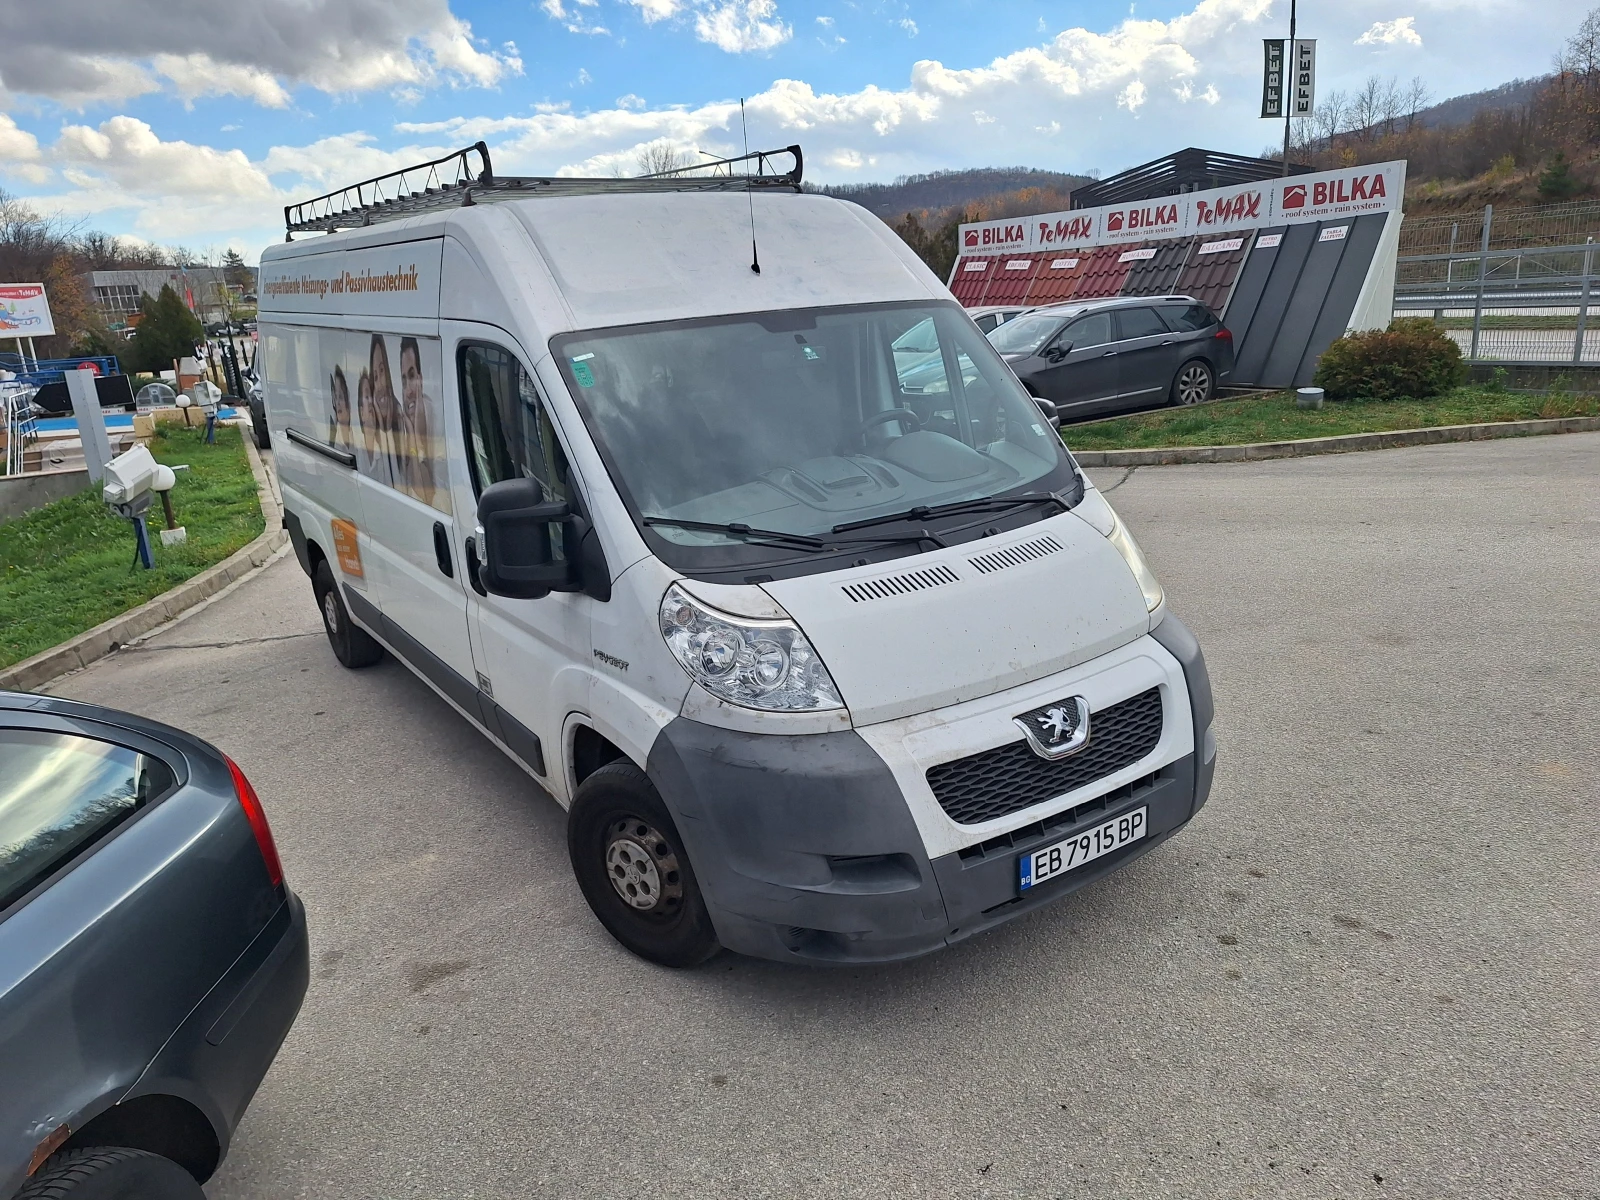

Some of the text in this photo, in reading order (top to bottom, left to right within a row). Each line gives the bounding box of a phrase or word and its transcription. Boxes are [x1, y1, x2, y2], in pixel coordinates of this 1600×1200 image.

[1266, 44, 1280, 113] EFBET
[1298, 44, 1311, 112] EFBET
[1313, 174, 1386, 206] BILKA
[1128, 204, 1178, 229] BILKA
[1196, 192, 1262, 226] TeMAX
[1285, 202, 1381, 218] roof system rain system
[982, 224, 1024, 245] BILKA
[1039, 217, 1092, 244] TeMAX
[1109, 231, 1120, 239] roof
[1120, 230, 1140, 239] system
[1154, 226, 1175, 235] system
[1121, 250, 1154, 261] ROMANIC
[1200, 240, 1242, 252] BALCANIC
[965, 262, 987, 270] CLASIC
[1054, 259, 1075, 267] GOTIC
[330, 270, 344, 294] und
[344, 263, 418, 293] Passivhaustechnik
[593, 648, 630, 671] PEUGEOT
[1035, 812, 1143, 880] EB 7915 BP
[1021, 875, 1031, 886] BG
